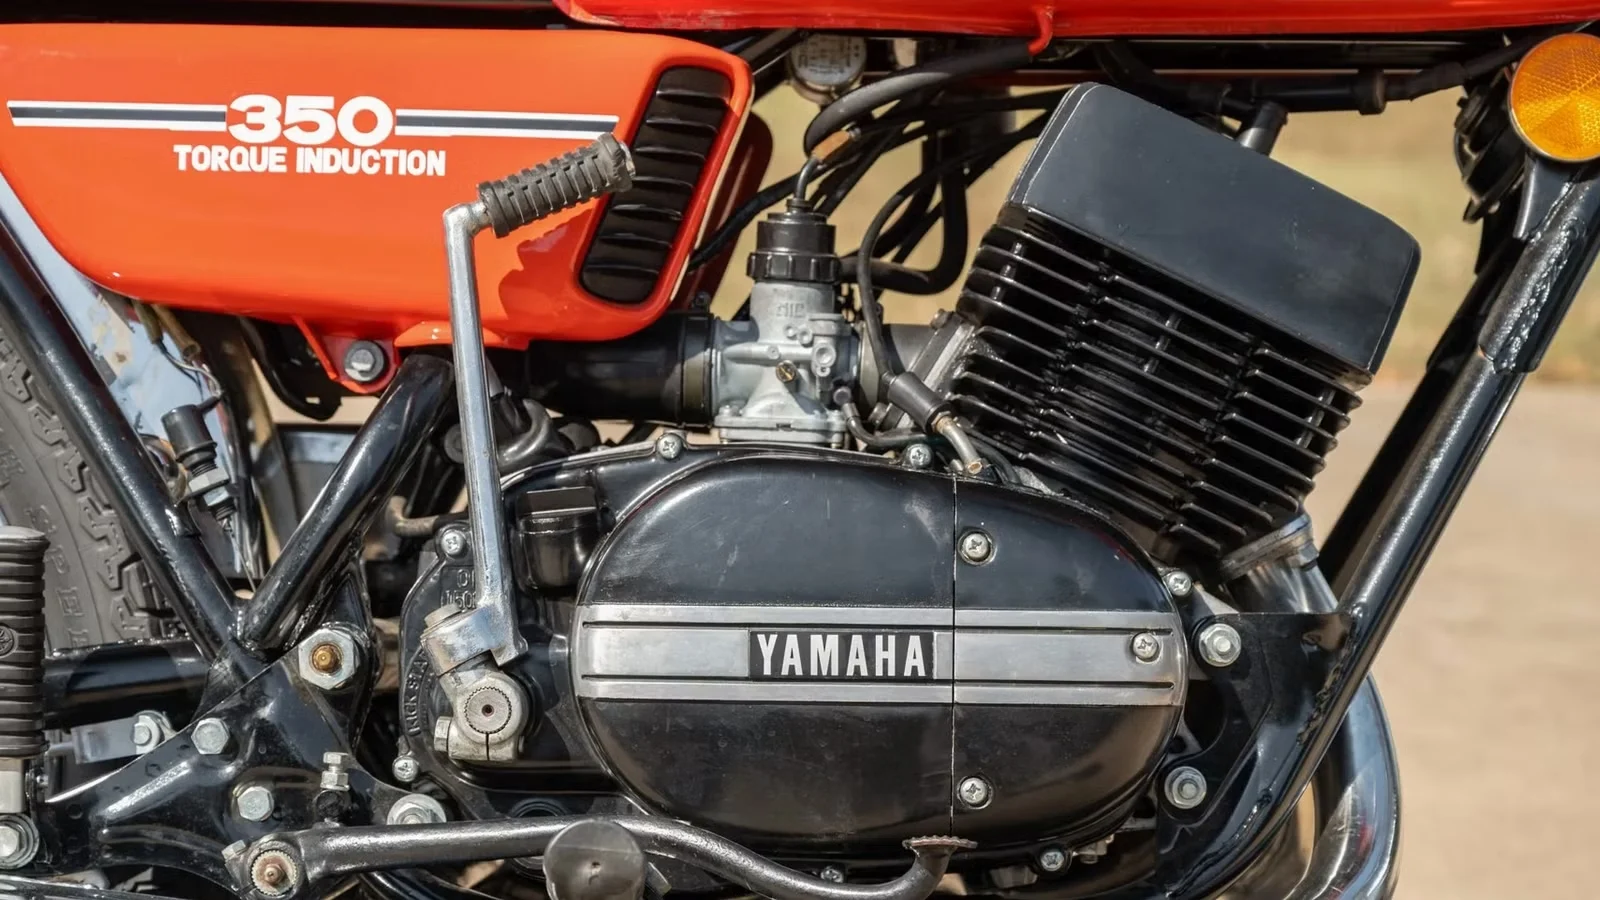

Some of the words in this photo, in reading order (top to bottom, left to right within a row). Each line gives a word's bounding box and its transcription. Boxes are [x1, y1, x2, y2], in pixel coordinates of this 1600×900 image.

[228, 94, 393, 146] 350
[173, 144, 287, 173] TORQUE
[296, 146, 446, 176] INDUCTION
[756, 633, 926, 676] YAMAHA
